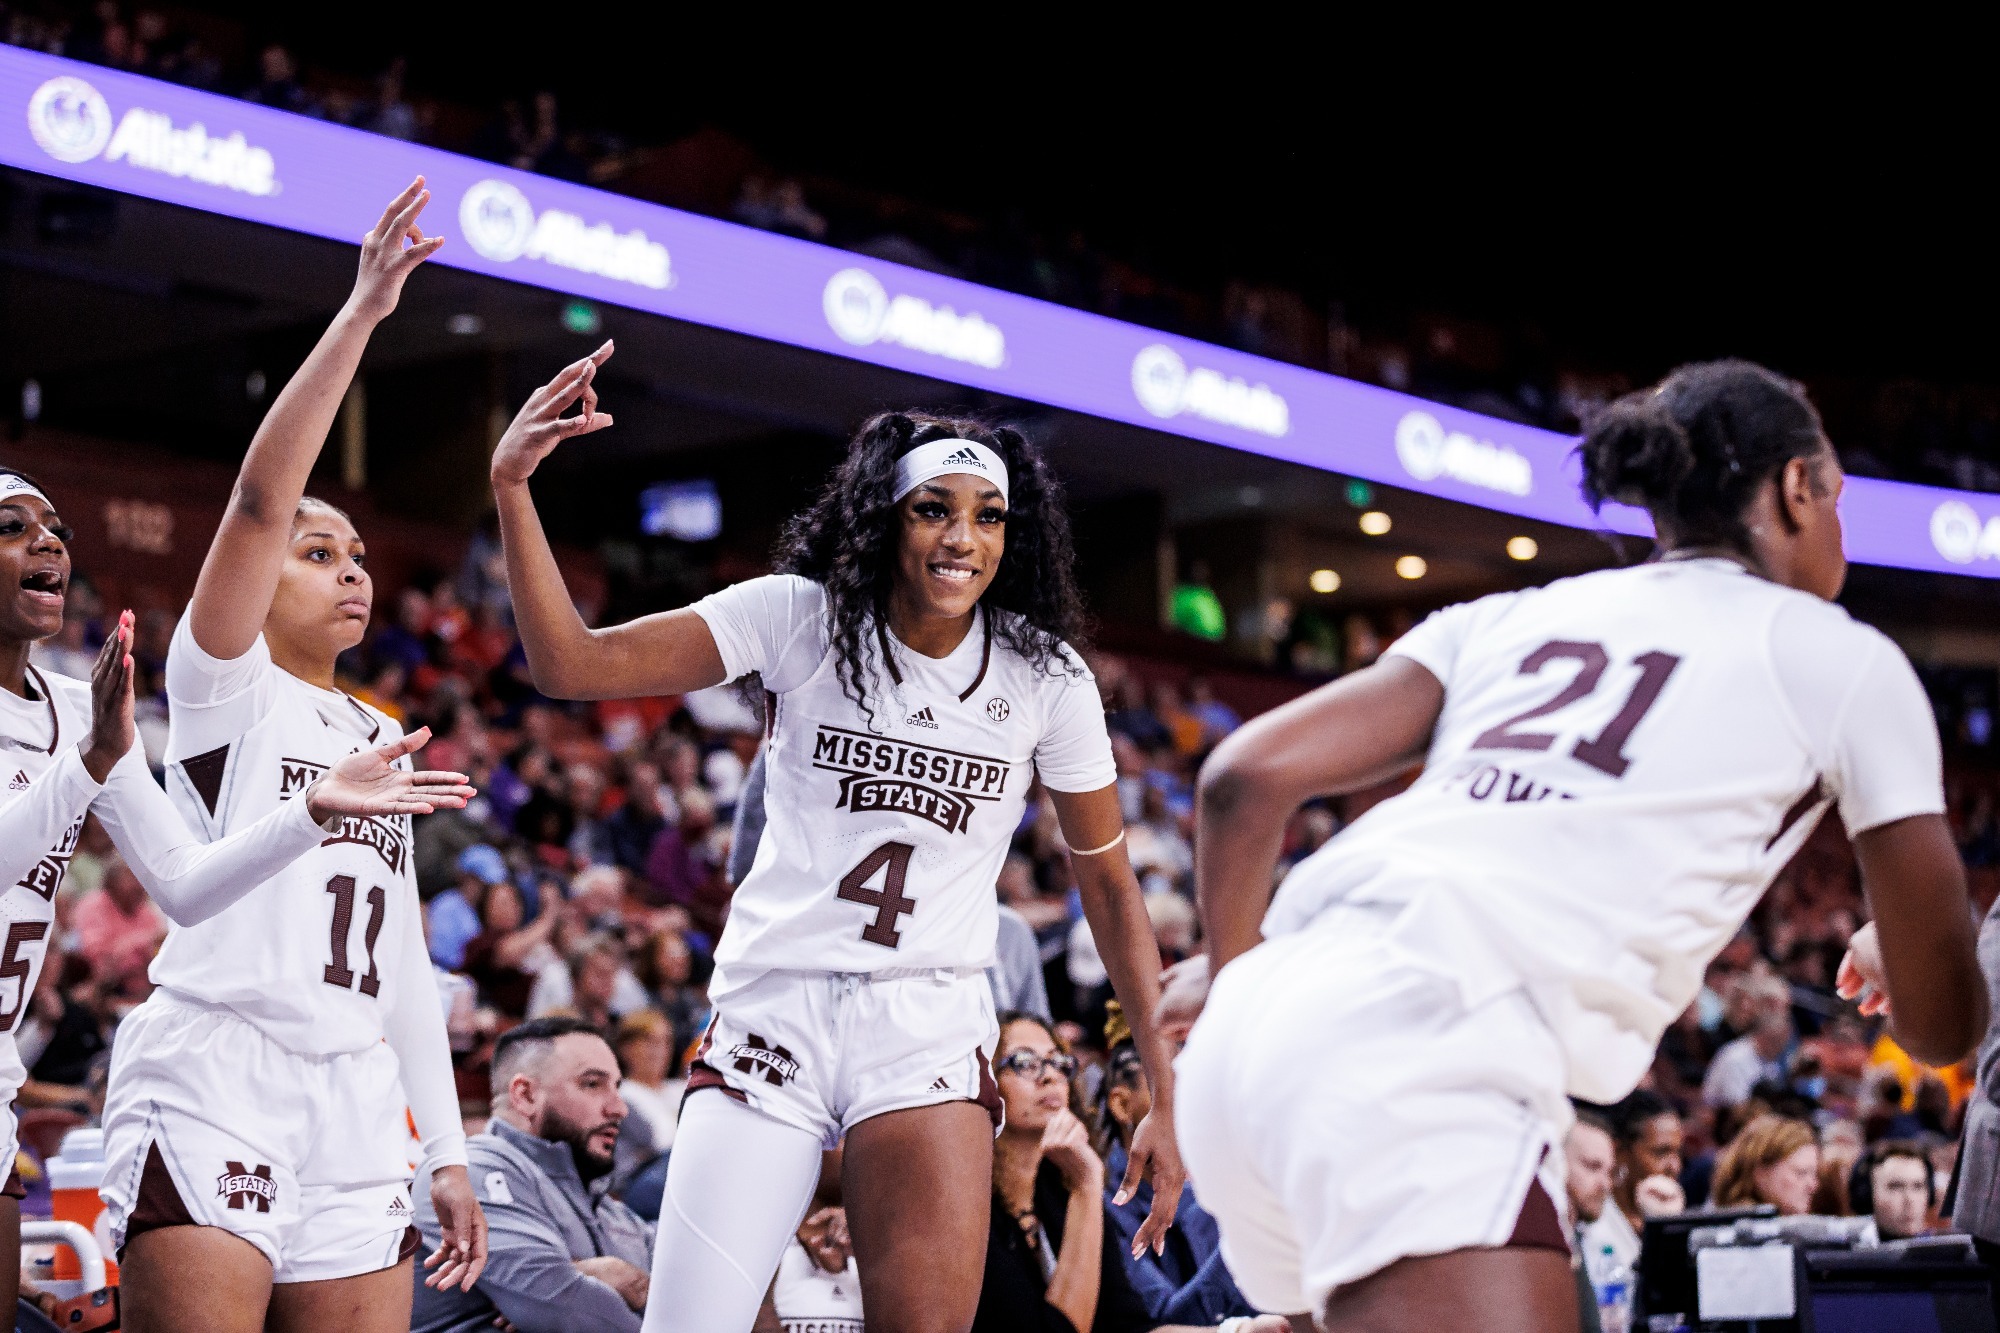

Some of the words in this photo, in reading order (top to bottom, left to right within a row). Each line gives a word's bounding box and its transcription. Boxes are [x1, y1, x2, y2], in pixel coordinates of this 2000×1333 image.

[105, 107, 275, 195] Allstate
[942, 457, 988, 470] adidas
[906, 718, 939, 730] adidas
[986, 698, 1010, 721] SEC
[1470, 640, 1680, 778] 21
[812, 732, 1010, 794] MISSISSIPPI
[860, 784, 953, 826] STATE
[836, 840, 917, 949] 4
[323, 873, 386, 999] 11
[742, 1048, 788, 1072] STATE
[230, 1176, 270, 1195] STATE
